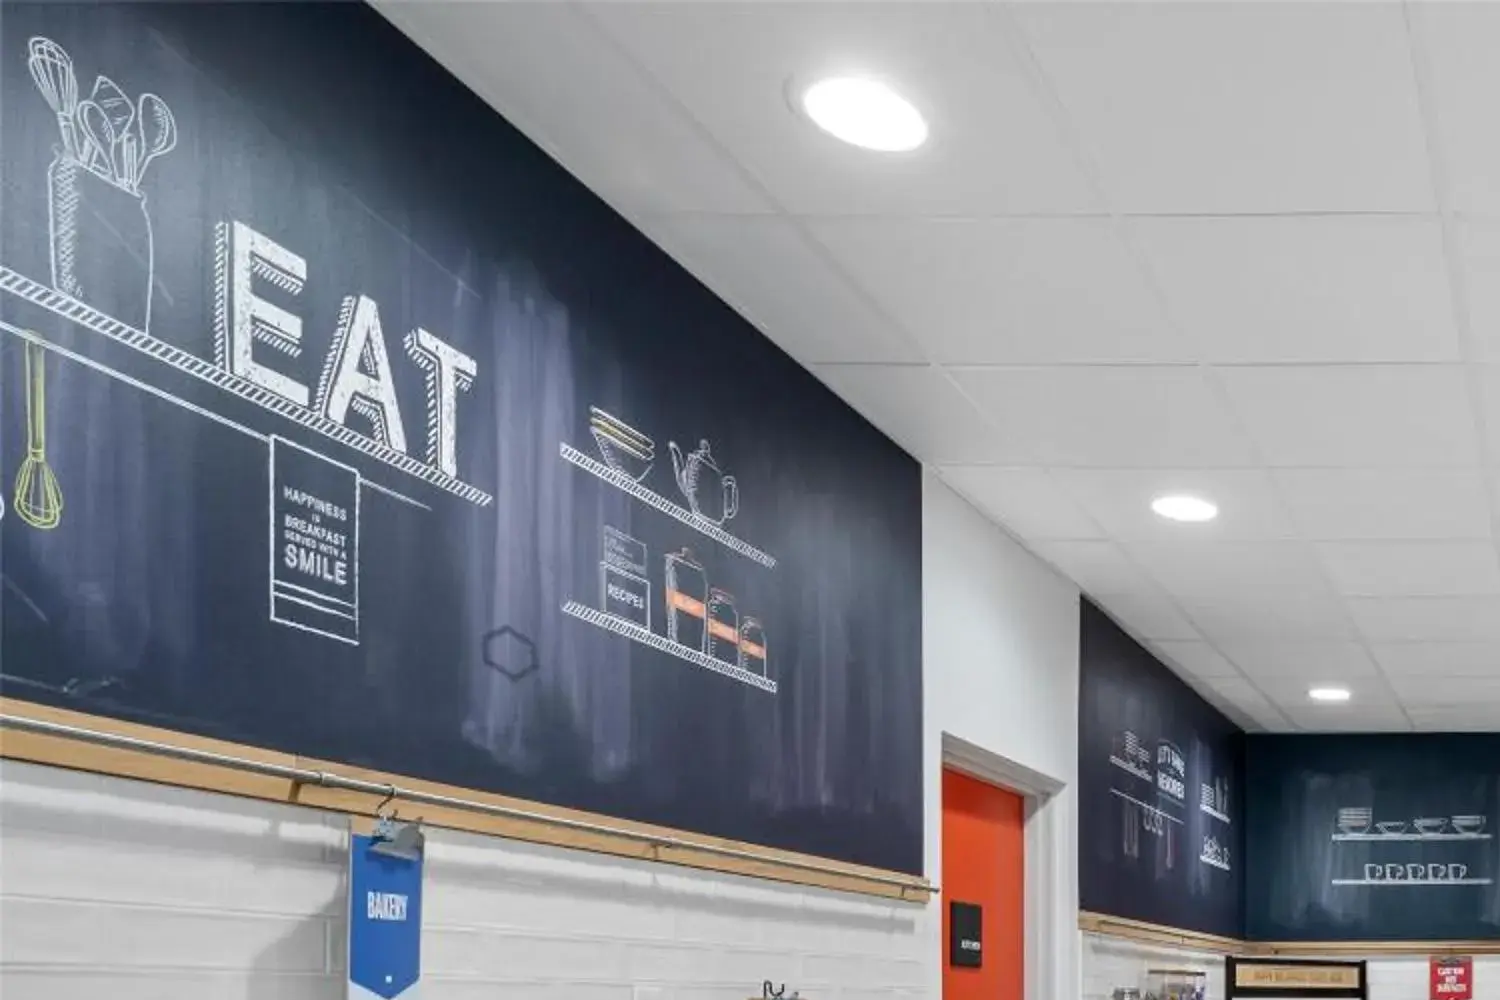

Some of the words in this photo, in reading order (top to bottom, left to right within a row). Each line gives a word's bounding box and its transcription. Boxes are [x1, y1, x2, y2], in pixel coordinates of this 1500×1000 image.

[215, 220, 477, 478] EAT
[283, 485, 347, 521] HAPPINESS
[285, 514, 346, 547] BREAKFAST
[285, 543, 347, 585] SMILE
[367, 891, 408, 921] BAKERY
